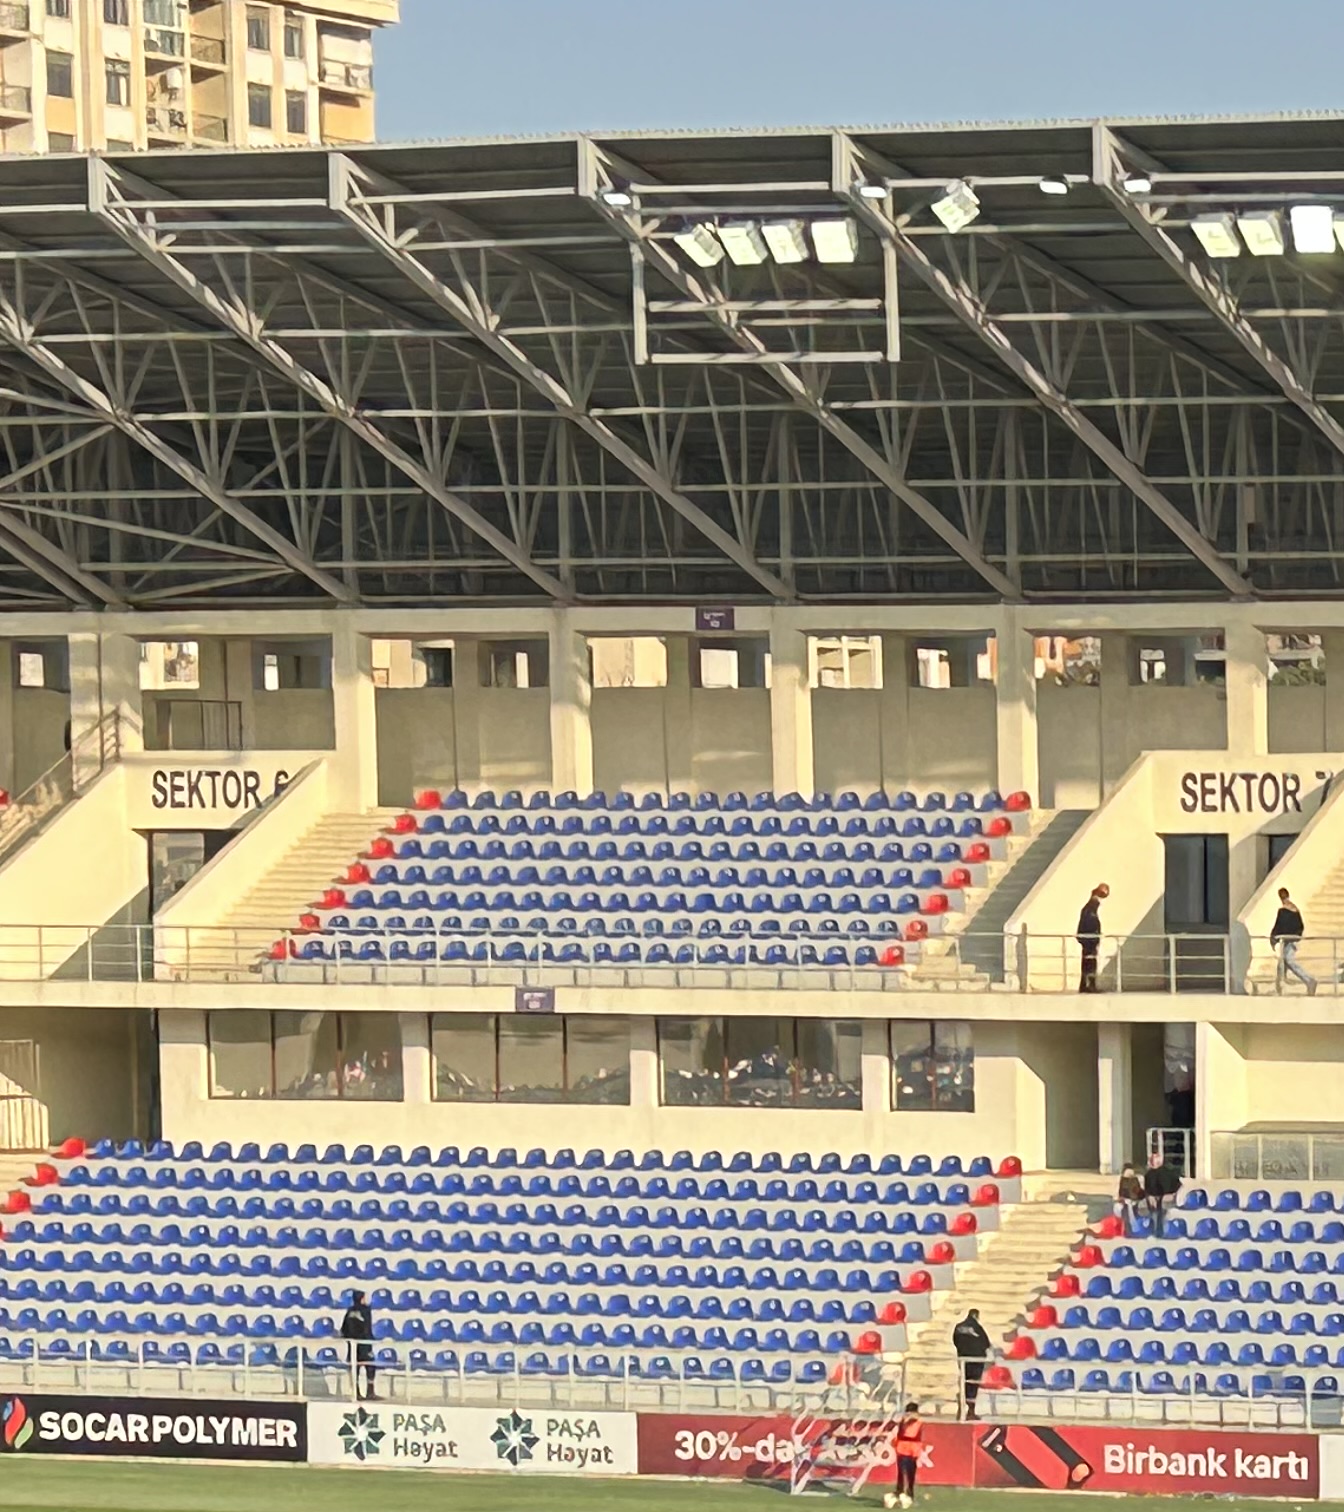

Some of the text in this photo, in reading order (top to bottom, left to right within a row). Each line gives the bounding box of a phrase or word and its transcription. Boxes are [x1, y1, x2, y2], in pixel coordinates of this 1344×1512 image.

[152, 769, 263, 809] SEKTOR
[1180, 771, 1303, 813] SEKTOR
[38, 1411, 298, 1448] SOCAR POLYMER
[393, 1413, 447, 1437] PAŞA
[546, 1418, 601, 1442] PAŞA
[393, 1437, 458, 1464] Həyat
[546, 1442, 614, 1468] Həyat
[1103, 1444, 1309, 1481] Birbank kartı
